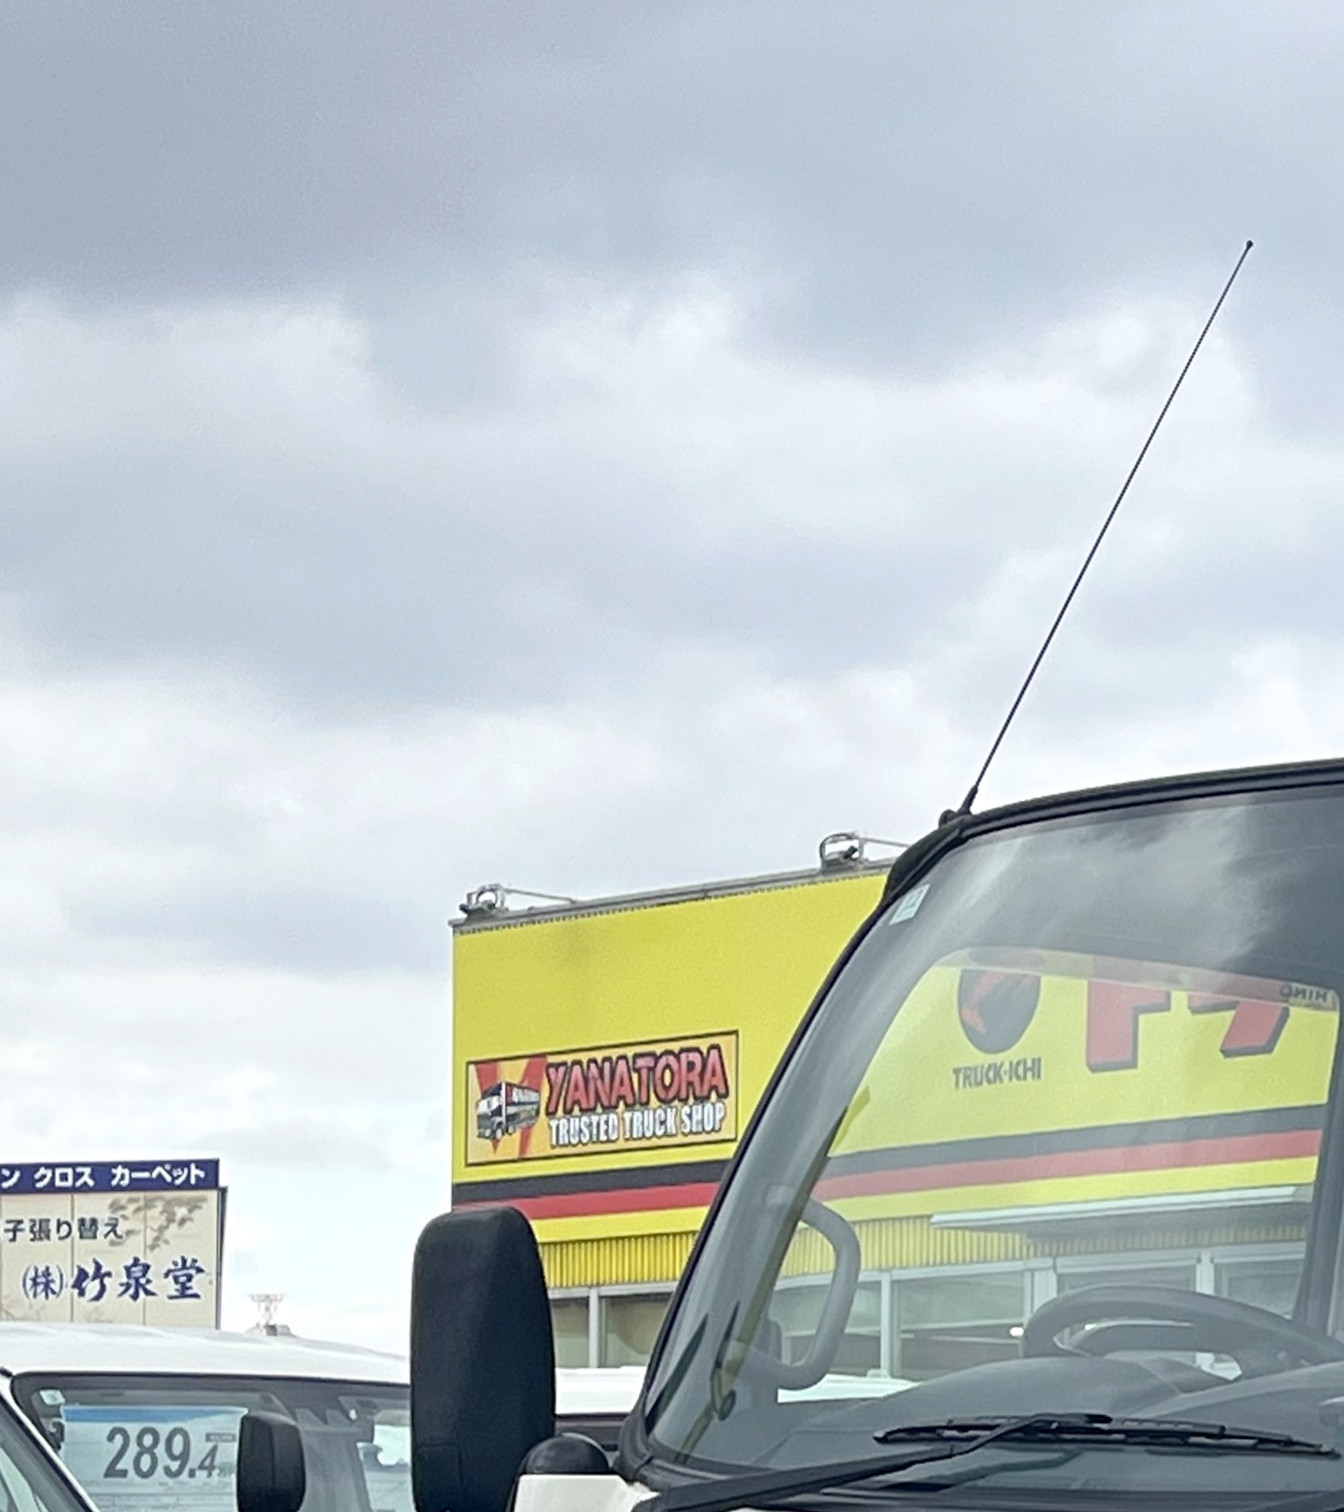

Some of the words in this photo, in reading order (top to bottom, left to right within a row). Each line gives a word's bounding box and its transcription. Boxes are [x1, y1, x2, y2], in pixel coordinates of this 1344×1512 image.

[545, 1044, 729, 1116] YANATORA
[550, 1114, 619, 1147] TRUSTED
[623, 1107, 677, 1142] TRUCK
[681, 1102, 726, 1136] SHOP
[34, 1167, 95, 1188] クロス
[111, 1163, 205, 1187] カーペット
